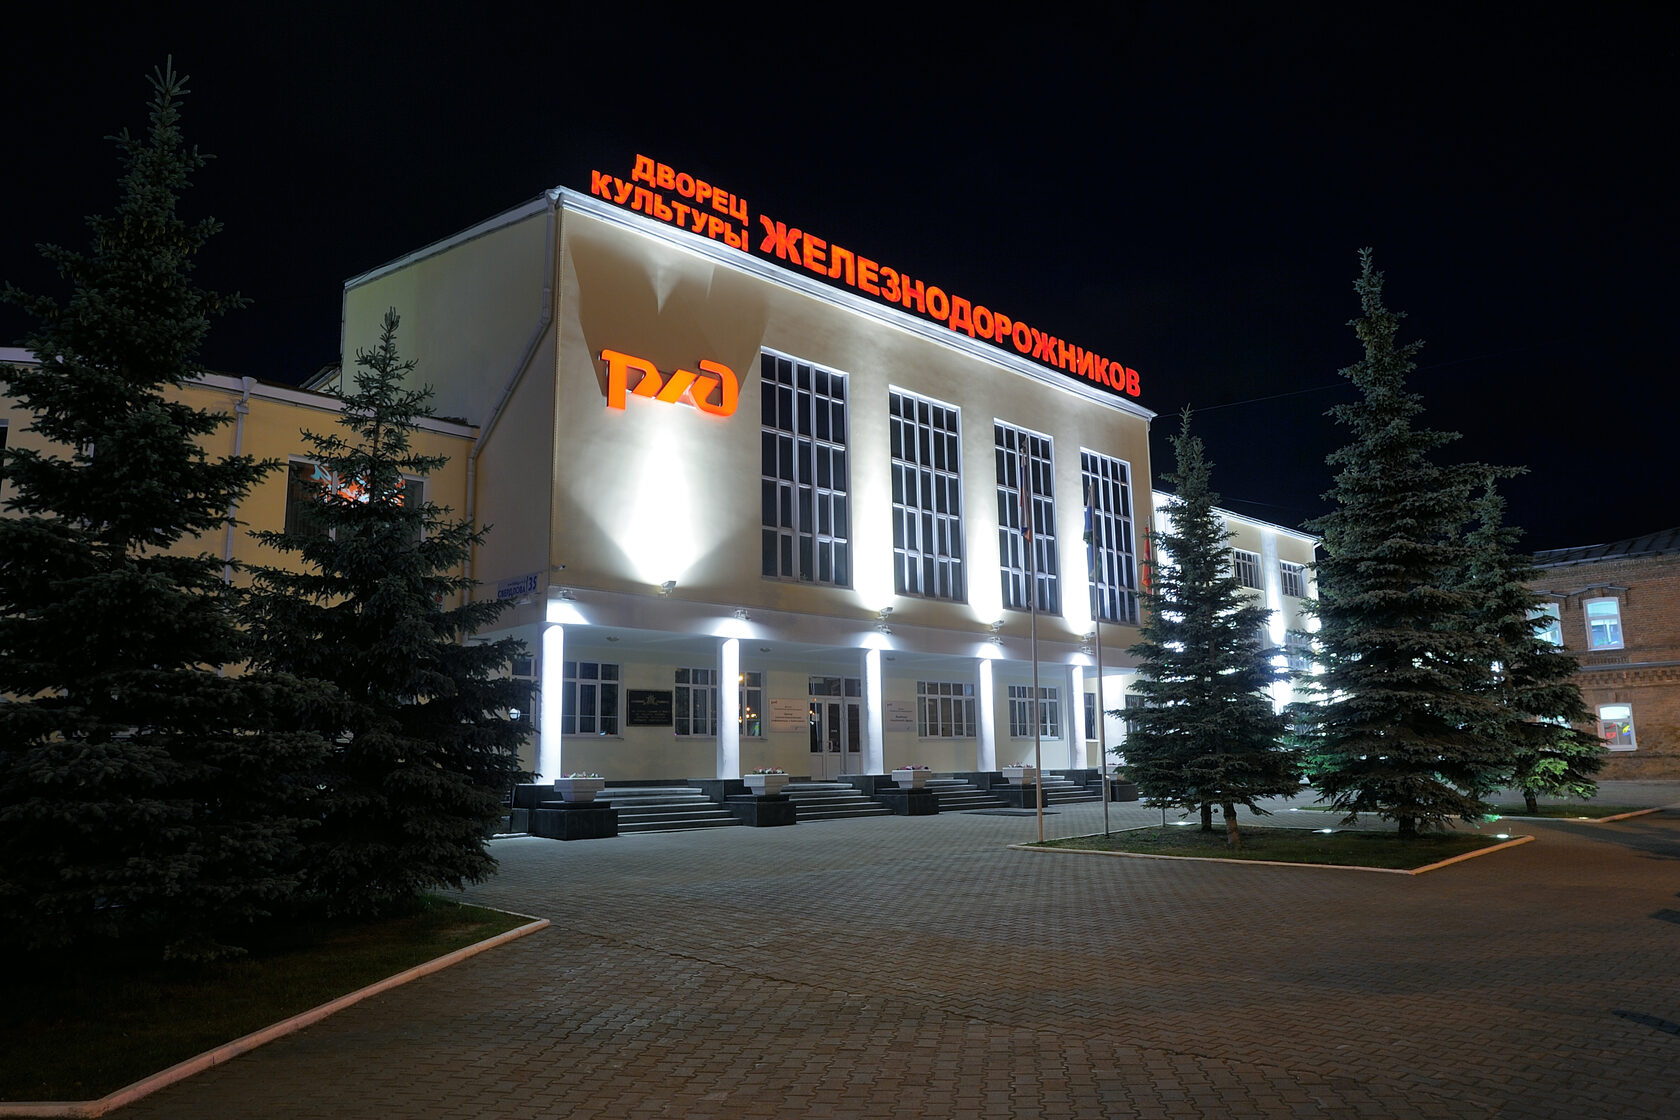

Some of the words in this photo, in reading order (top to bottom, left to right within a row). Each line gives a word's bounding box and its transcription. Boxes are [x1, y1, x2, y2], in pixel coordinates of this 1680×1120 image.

[590, 169, 749, 253] КУЛЬТУРЫ
[631, 153, 749, 226] ДВОРЕЦ
[759, 214, 1142, 398] ЖЕЛЕЗНОДОРОЖНИКОВ
[528, 575, 538, 591] 35
